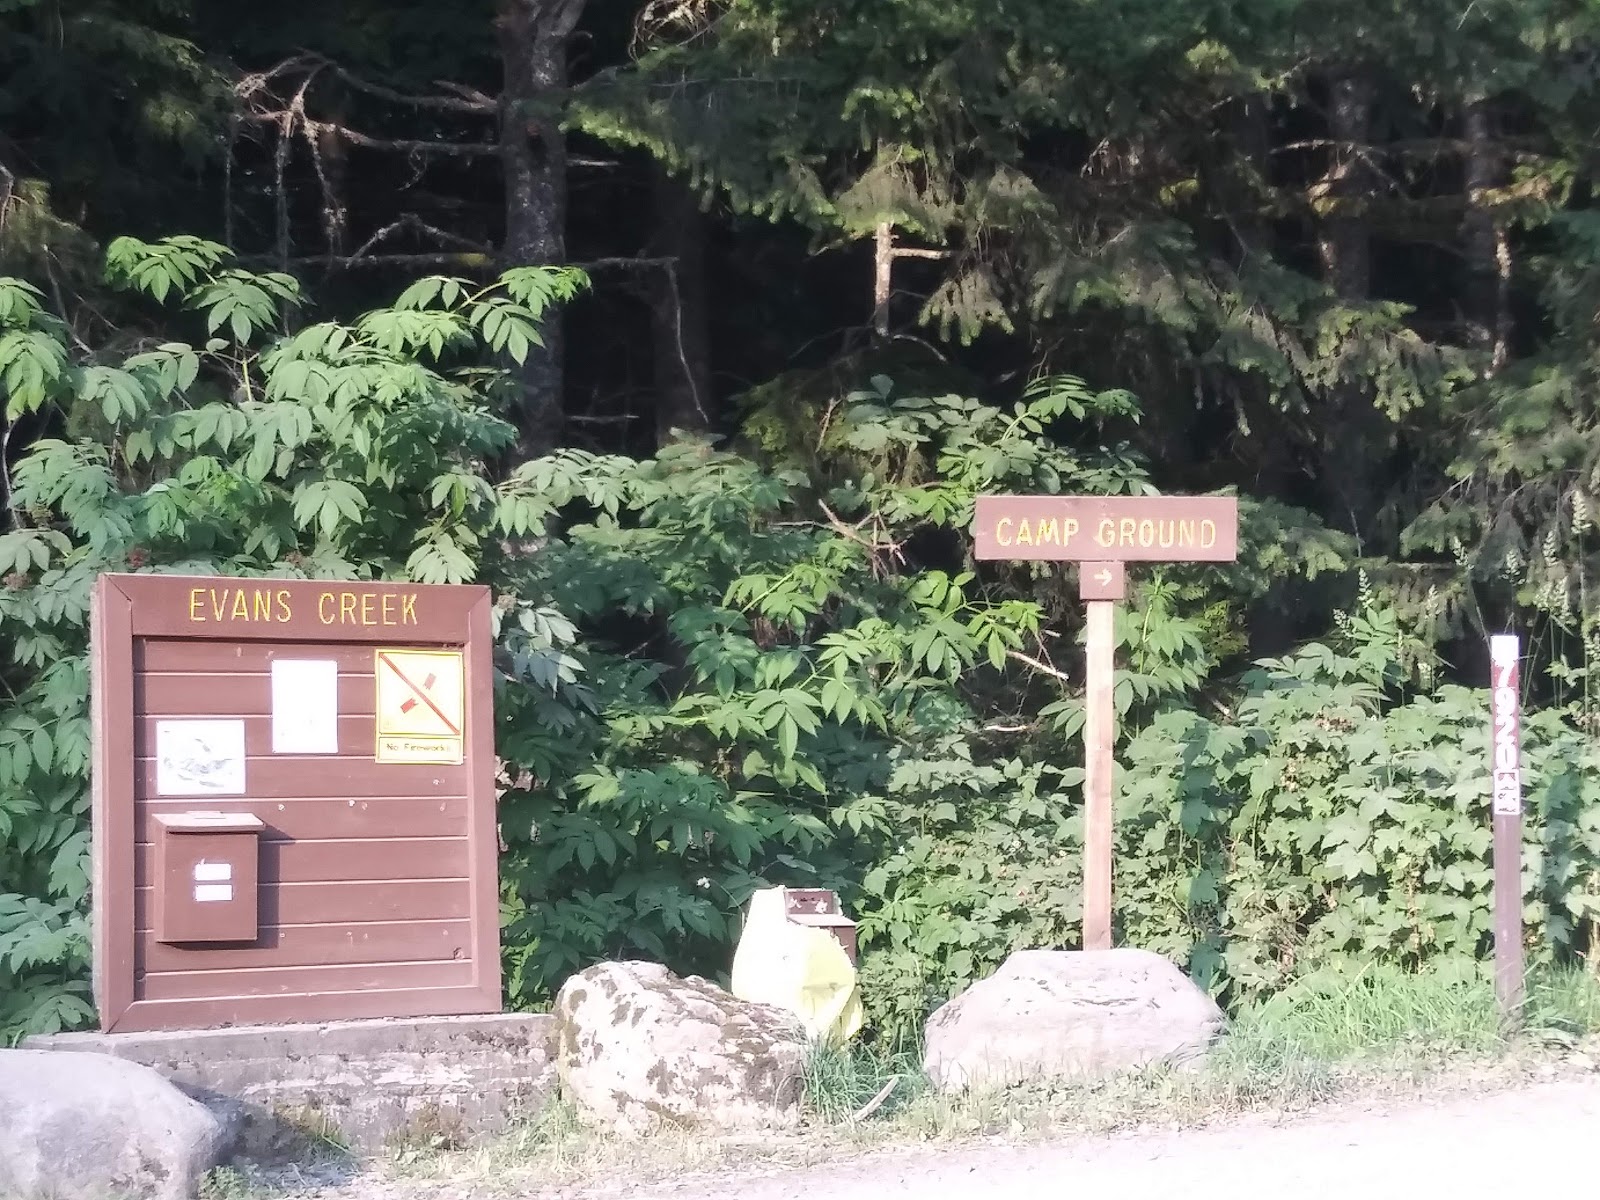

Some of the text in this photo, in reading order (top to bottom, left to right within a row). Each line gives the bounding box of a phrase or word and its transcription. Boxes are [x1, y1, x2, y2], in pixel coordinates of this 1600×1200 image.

[996, 517, 1217, 549] CAMP GROUND
[189, 588, 418, 625] EVANS CREEK
[1494, 657, 1517, 768] 7920
